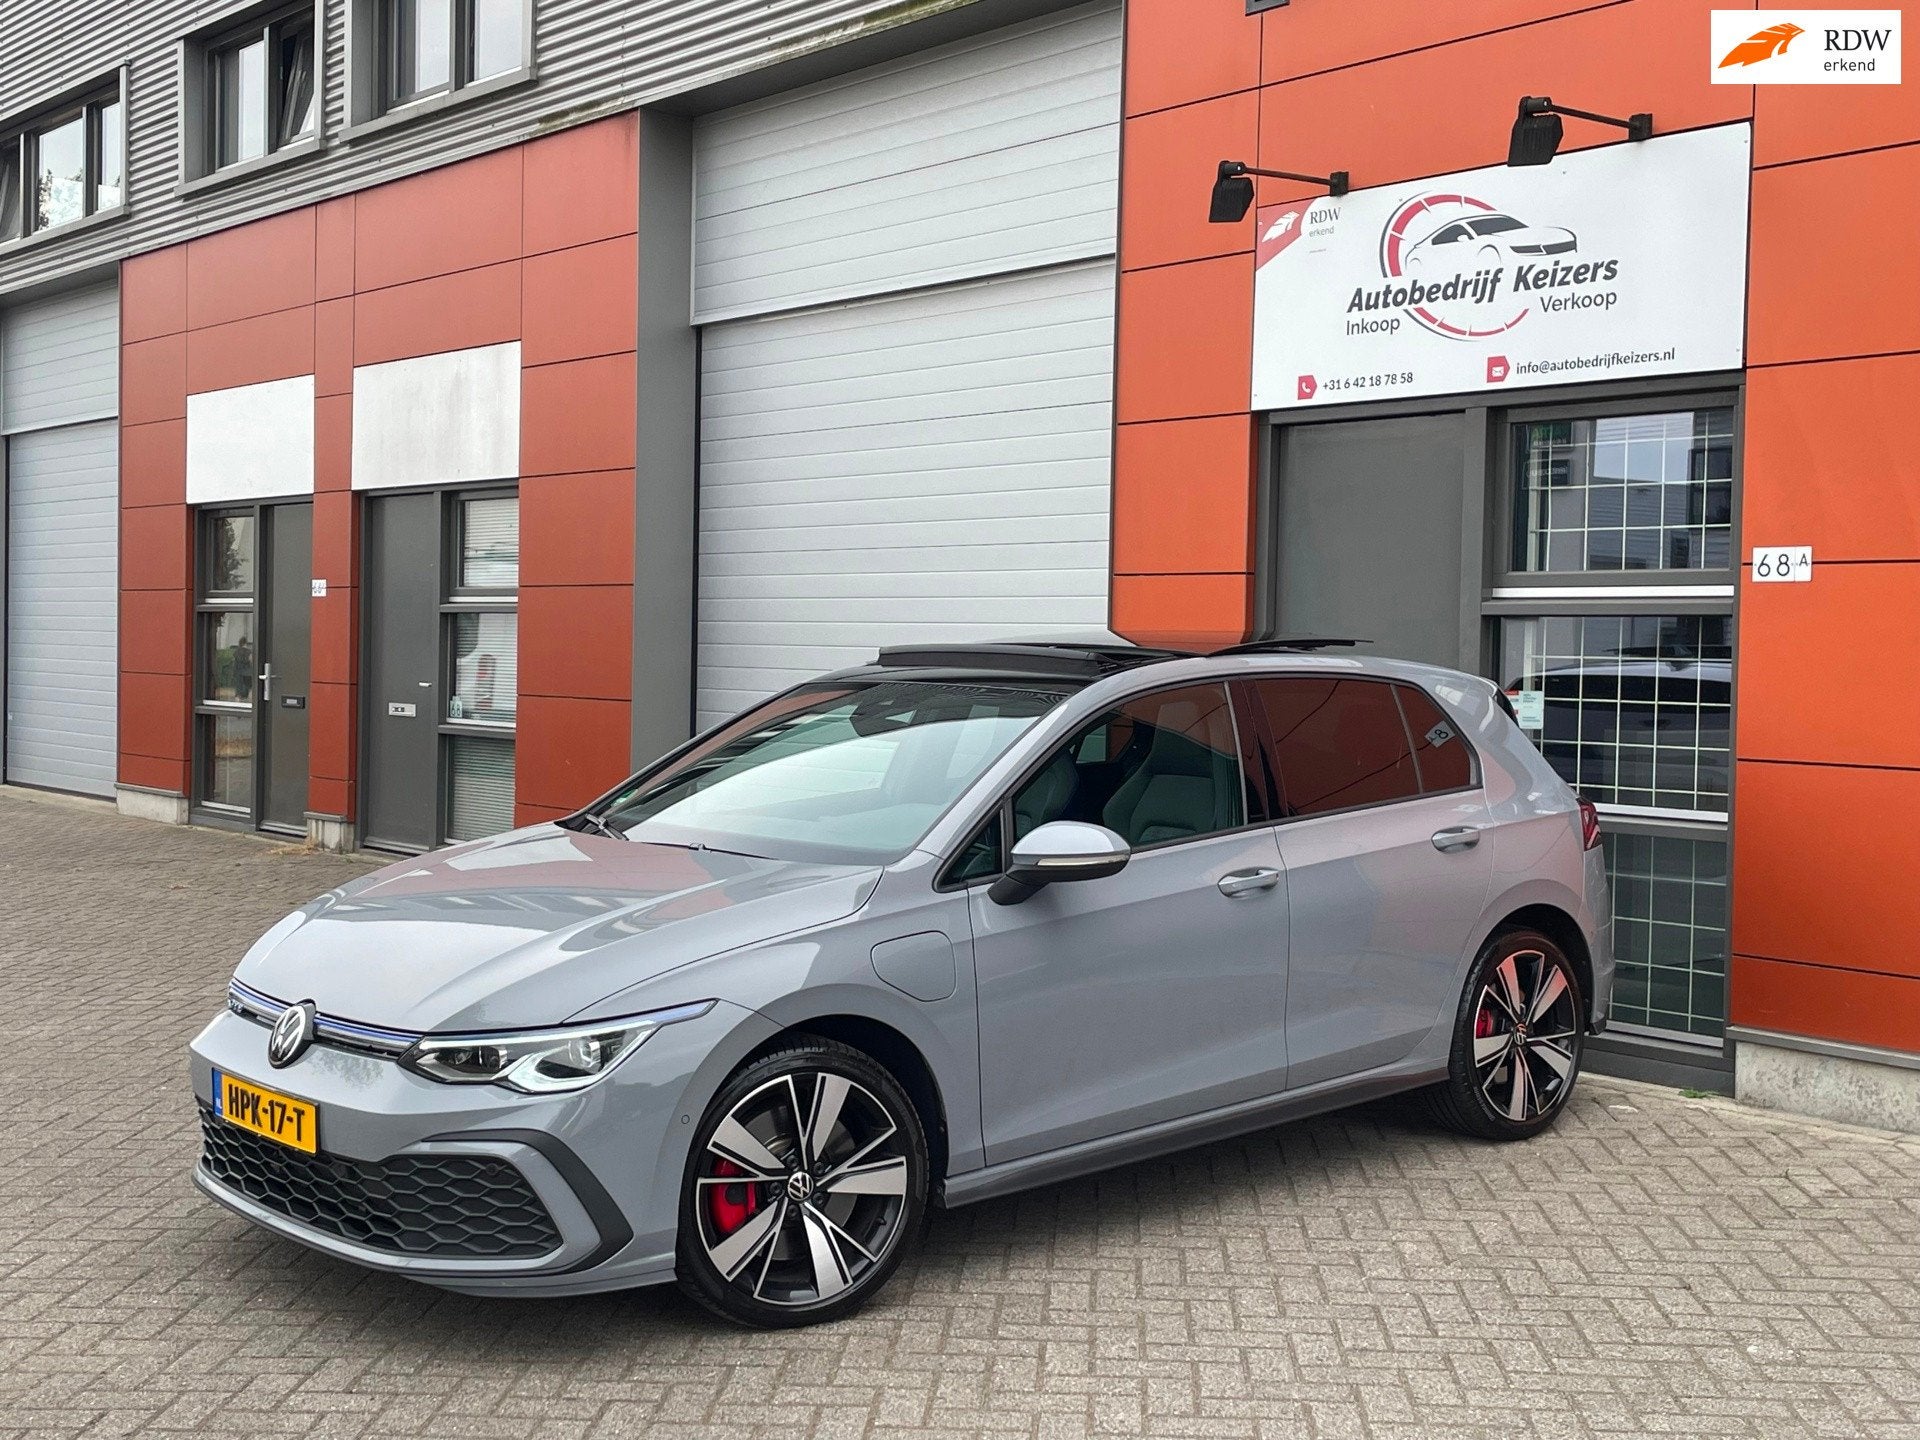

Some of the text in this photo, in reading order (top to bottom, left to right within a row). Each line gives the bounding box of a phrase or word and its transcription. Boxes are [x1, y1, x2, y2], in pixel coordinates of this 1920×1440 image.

[1309, 206, 1341, 225] RDW
[1309, 225, 1335, 238] erkend
[1346, 259, 1619, 314] Autobedrijf Keizers
[1539, 291, 1618, 313] Verkoop
[1346, 317, 1401, 336] Inkoop
[1516, 347, 1676, 375] info@autobedrijfkeizers.nl
[1323, 371, 1414, 391] +31 6 42 18 78 58
[1757, 553, 1790, 577] 68
[228, 1084, 305, 1142] HPK-17-T
